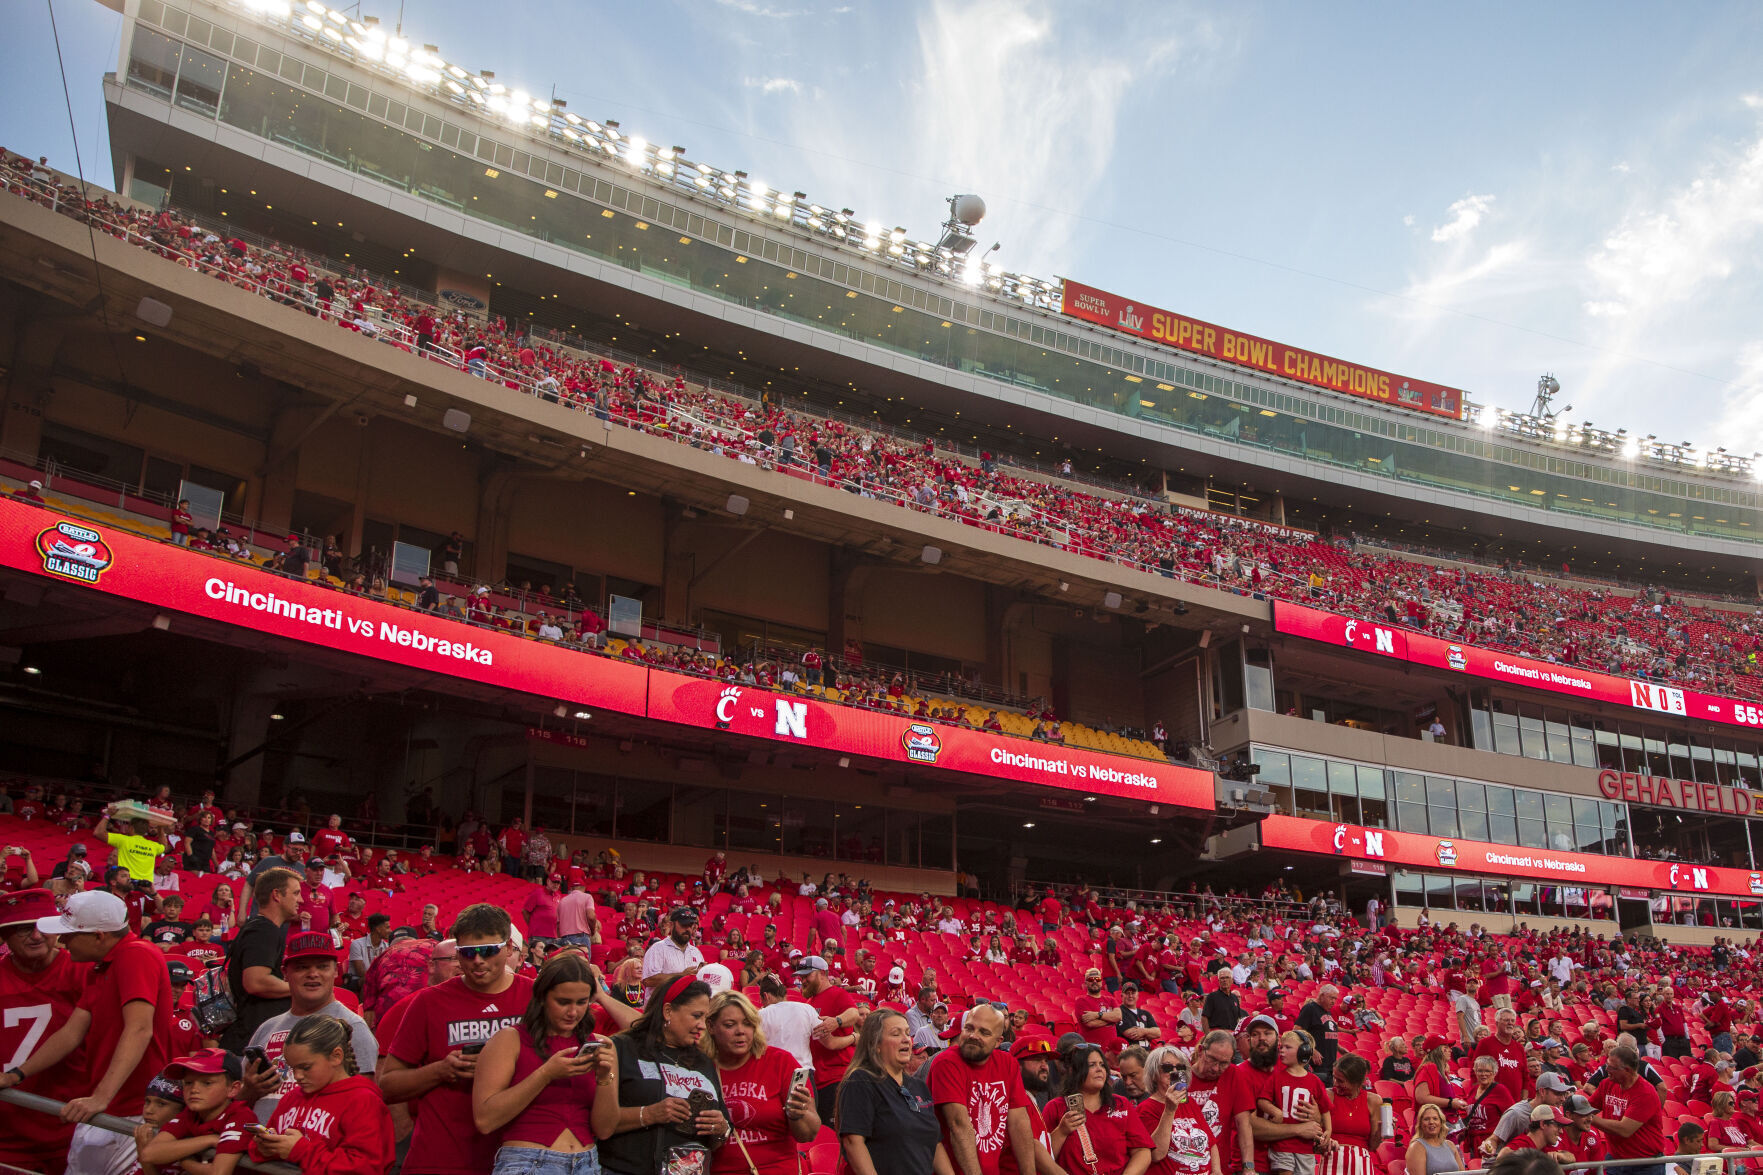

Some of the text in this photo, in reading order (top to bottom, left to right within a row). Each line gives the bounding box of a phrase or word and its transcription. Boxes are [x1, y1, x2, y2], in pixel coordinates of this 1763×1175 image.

[1074, 300, 1110, 317] BOWL IV
[1079, 293, 1106, 307] SUPER
[1152, 313, 1390, 399] SUPER BOWL CHAMPIONS
[47, 557, 98, 581] CLASSIC
[205, 577, 493, 666] Cincinnati vs Nebraska
[1375, 627, 1394, 653] N
[1494, 660, 1592, 690] Cincinnati vs Nebraska
[1634, 683, 1669, 711] N 0
[1676, 700, 1682, 710] 3
[716, 693, 807, 738] C vs N
[910, 749, 936, 761] CLASSIC
[990, 748, 1158, 789] Cincinnati vs Nebraska
[1599, 769, 1751, 816] GEHA FIELD
[1365, 831, 1385, 857] N
[1485, 852, 1586, 873] Cincinnati vs Nebraska
[1692, 867, 1708, 889] N
[448, 1016, 522, 1042] NEBRASK
[661, 1065, 704, 1092] Huskers
